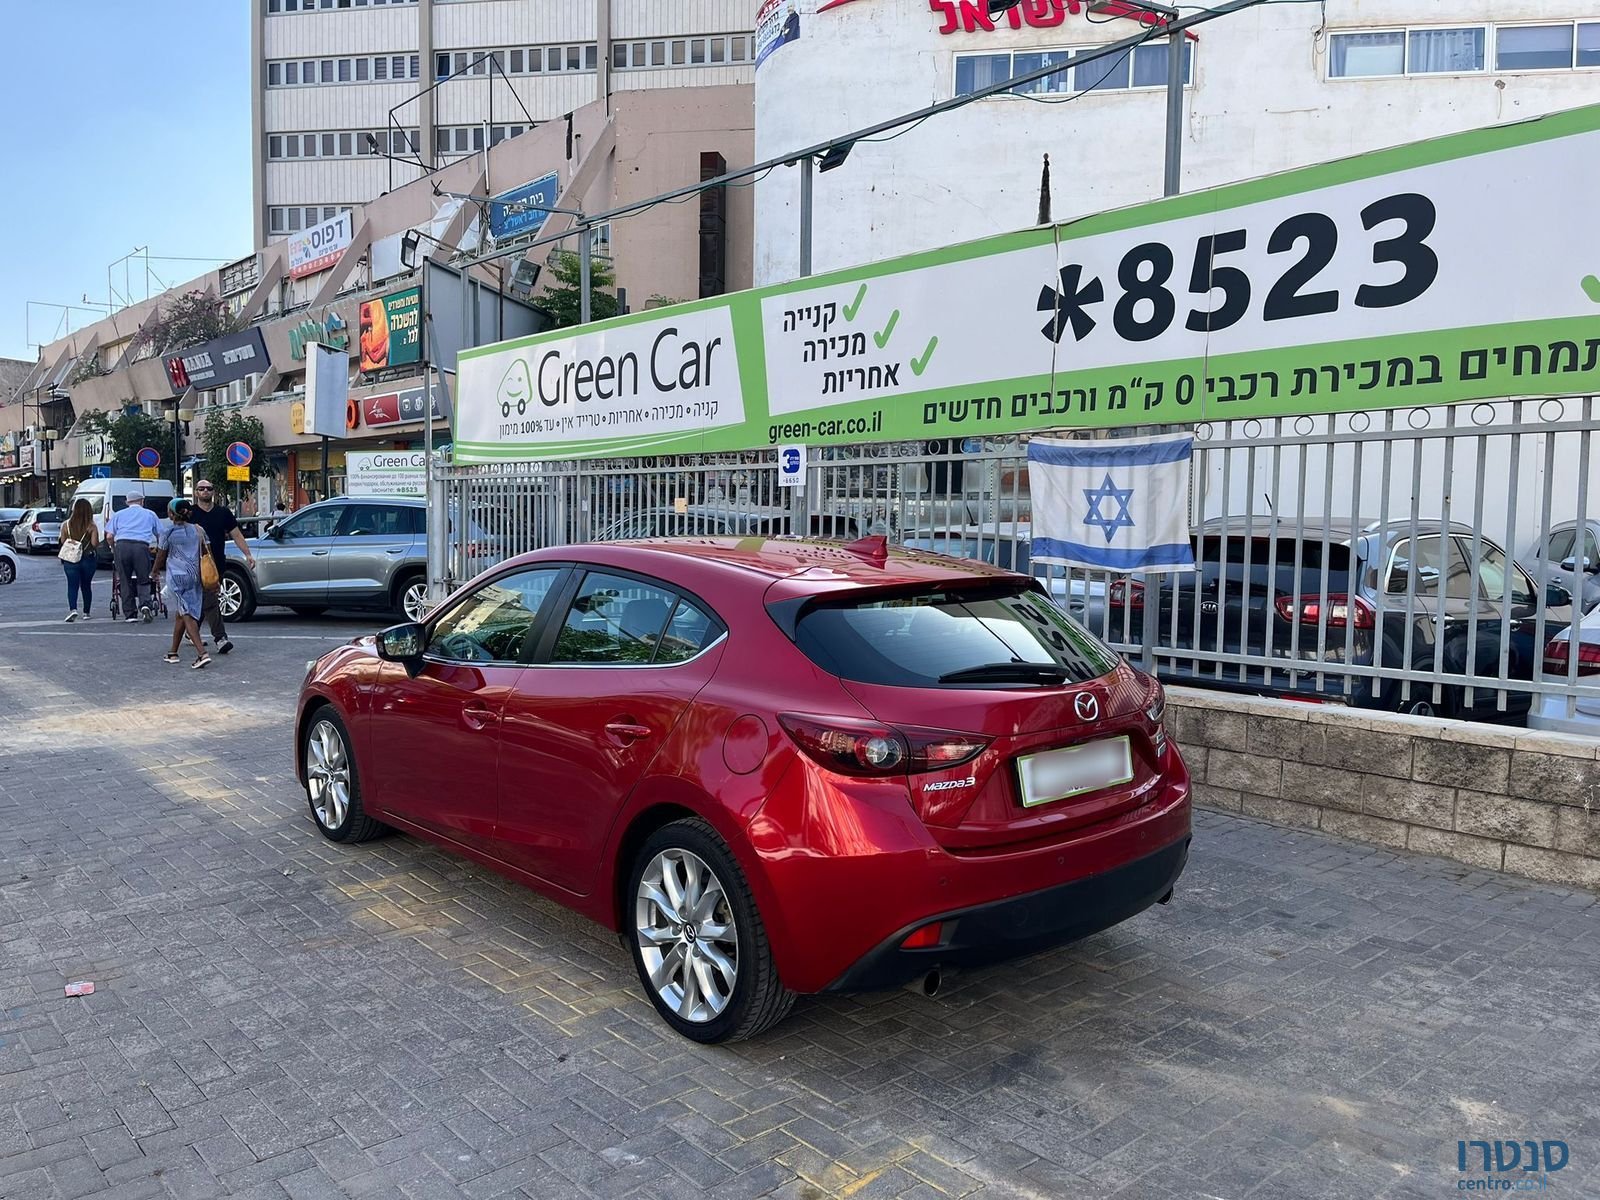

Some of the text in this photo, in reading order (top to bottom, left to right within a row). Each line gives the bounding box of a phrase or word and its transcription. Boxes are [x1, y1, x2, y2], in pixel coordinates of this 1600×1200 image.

[311, 219, 344, 249] דפוס
[390, 307, 418, 331] להשכרה
[784, 302, 837, 332] קנייה
[803, 332, 866, 362] מכירה
[539, 327, 721, 407] Green Car
[822, 362, 901, 394] אחריות
[1291, 355, 1442, 396] במכירת
[1012, 387, 1097, 418] ורכבים
[1176, 374, 1195, 406] 0
[1206, 371, 1279, 403] רכבי
[499, 401, 718, 440] קניה מכירה אחריות טרייד אין עד 100% מימון
[923, 397, 1002, 425] חדשים
[769, 411, 882, 443] green-car.co.il
[373, 454, 426, 468] Green Ca
